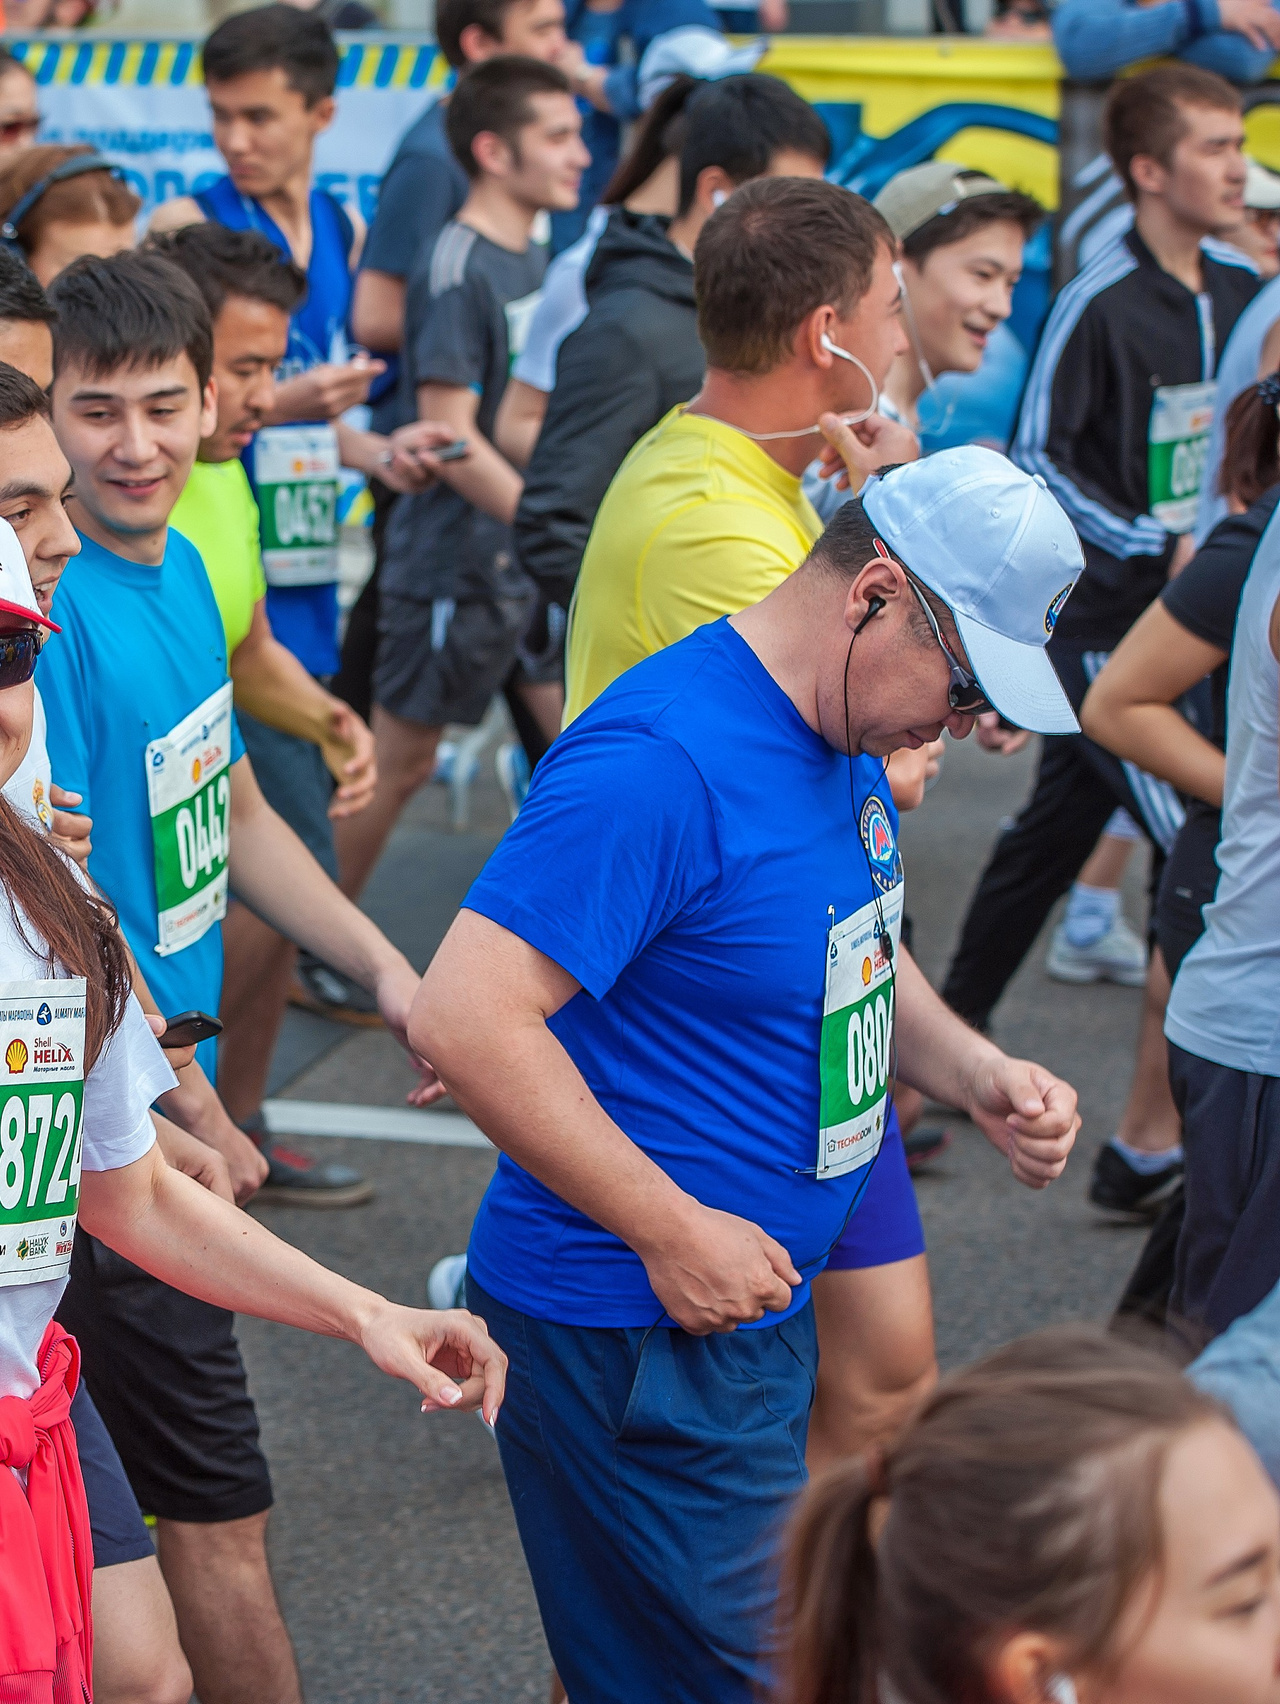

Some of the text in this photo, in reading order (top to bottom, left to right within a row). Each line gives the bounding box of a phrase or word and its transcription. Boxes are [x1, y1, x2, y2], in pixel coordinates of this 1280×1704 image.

[34, 1037, 52, 1048] Shell
[34, 1045, 74, 1063] HELIX
[30, 1236, 49, 1247] HALYK
[30, 1245, 47, 1256] BANK
